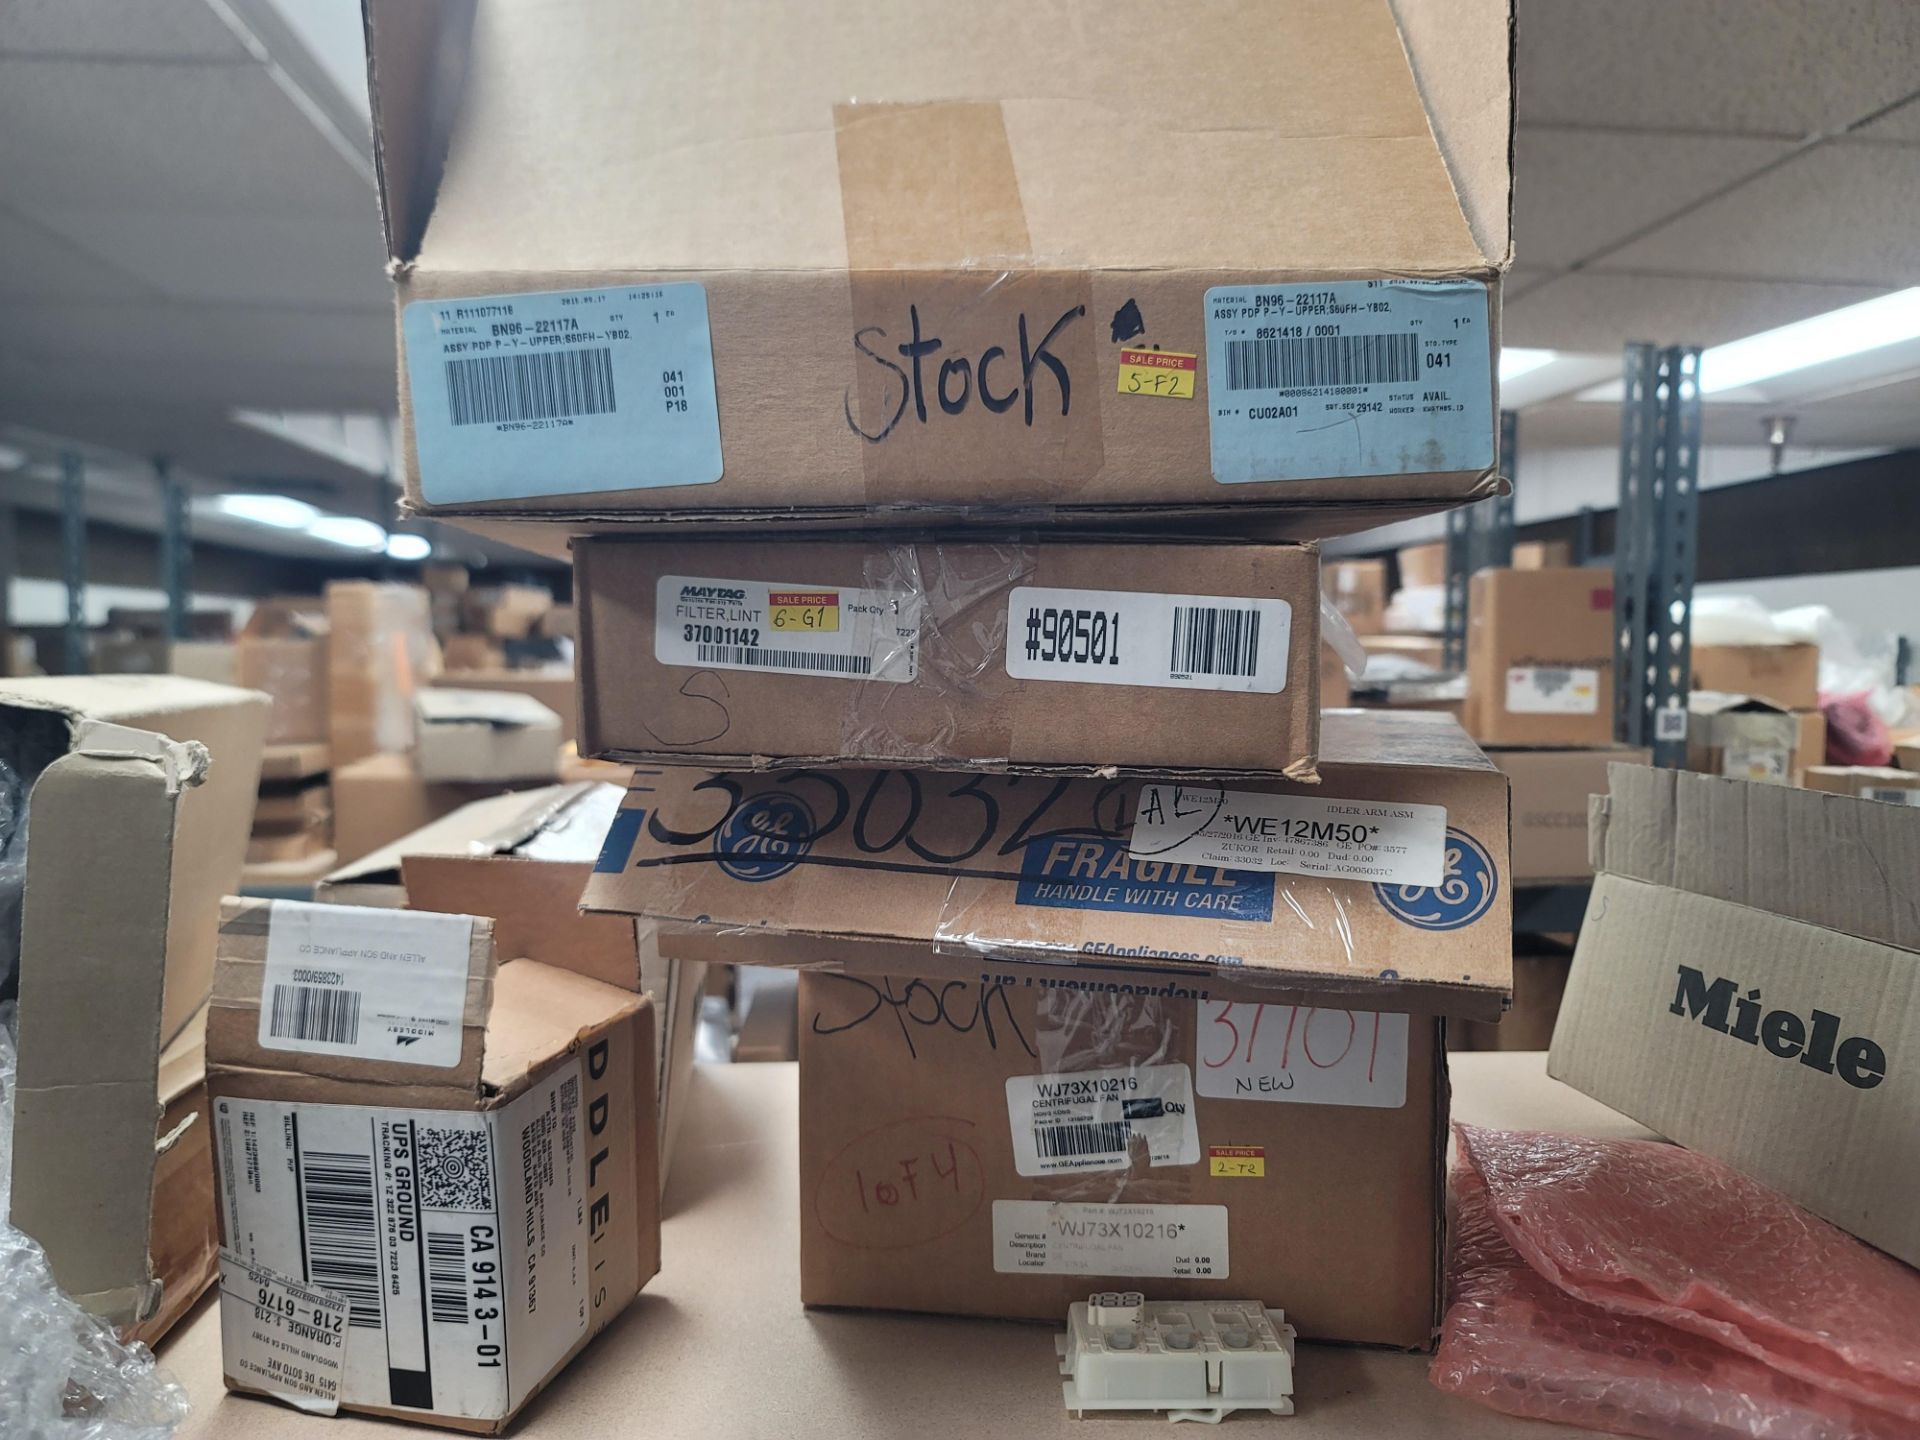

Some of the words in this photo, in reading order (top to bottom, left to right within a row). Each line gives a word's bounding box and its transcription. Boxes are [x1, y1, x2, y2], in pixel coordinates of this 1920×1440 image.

[1214, 308, 1238, 320] ASSY
[1241, 307, 1260, 318] PDP
[1453, 318, 1459, 329] 1
[1256, 325, 1302, 339] 8621418
[1315, 325, 1341, 336] 0001
[443, 342, 469, 354] ASSY
[472, 340, 492, 351] PDP
[1129, 354, 1153, 366] SALE
[1156, 356, 1184, 368] PRICE
[1426, 353, 1451, 368] 041
[663, 371, 684, 384] 041
[845, 303, 1086, 444] Stock
[664, 386, 686, 399] 001
[666, 400, 688, 413] P18
[1356, 402, 1383, 414] 29142
[680, 586, 746, 599] MAYTAG
[777, 596, 800, 604] SALE
[802, 596, 828, 605] PRICE
[847, 604, 867, 614] Pack
[868, 605, 884, 616] Qty
[684, 624, 760, 646] 37001142
[1025, 607, 1119, 665] #90501
[1327, 805, 1361, 815] IDLER
[1361, 808, 1387, 817] ARM
[1390, 810, 1414, 819] ASM
[1245, 833, 1260, 843] GE
[1336, 841, 1352, 850] GE
[1221, 842, 1258, 854] ZUKOR
[1299, 849, 1320, 859] 0.00
[1353, 854, 1374, 863] 0.00
[1234, 856, 1263, 865] 33032
[1034, 882, 1119, 903] HANDLE
[1125, 887, 1179, 907] WITH
[1184, 891, 1244, 911] CARE
[1669, 964, 1886, 1089] Miele
[1037, 1077, 1138, 1098] WJ73X10216
[1235, 1072, 1294, 1094] NEW
[1032, 1095, 1097, 1108] CENTRIFUGAL
[1164, 1101, 1186, 1114] Qty
[381, 1121, 391, 1169] TRACKING
[392, 1122, 408, 1159] UPS
[1215, 1149, 1234, 1157] SALE
[1234, 1149, 1255, 1157] PRICE
[522, 1125, 533, 1205] WOODLAND
[394, 1166, 415, 1242] GROUND
[526, 1207, 536, 1247] HILLS
[469, 1225, 494, 1253] CA
[528, 1253, 536, 1275] CA
[1194, 1256, 1211, 1264] 0.00
[472, 1261, 497, 1300] 914
[528, 1275, 537, 1314] 91367
[254, 1306, 272, 1324] 218
[475, 1308, 501, 1368] 3-01
[280, 1342, 300, 1359] HILLS
[266, 1357, 281, 1372] AVE
[283, 1363, 302, 1380] SOTO
[304, 1371, 316, 1384] DE
[319, 1377, 337, 1391] 6415
